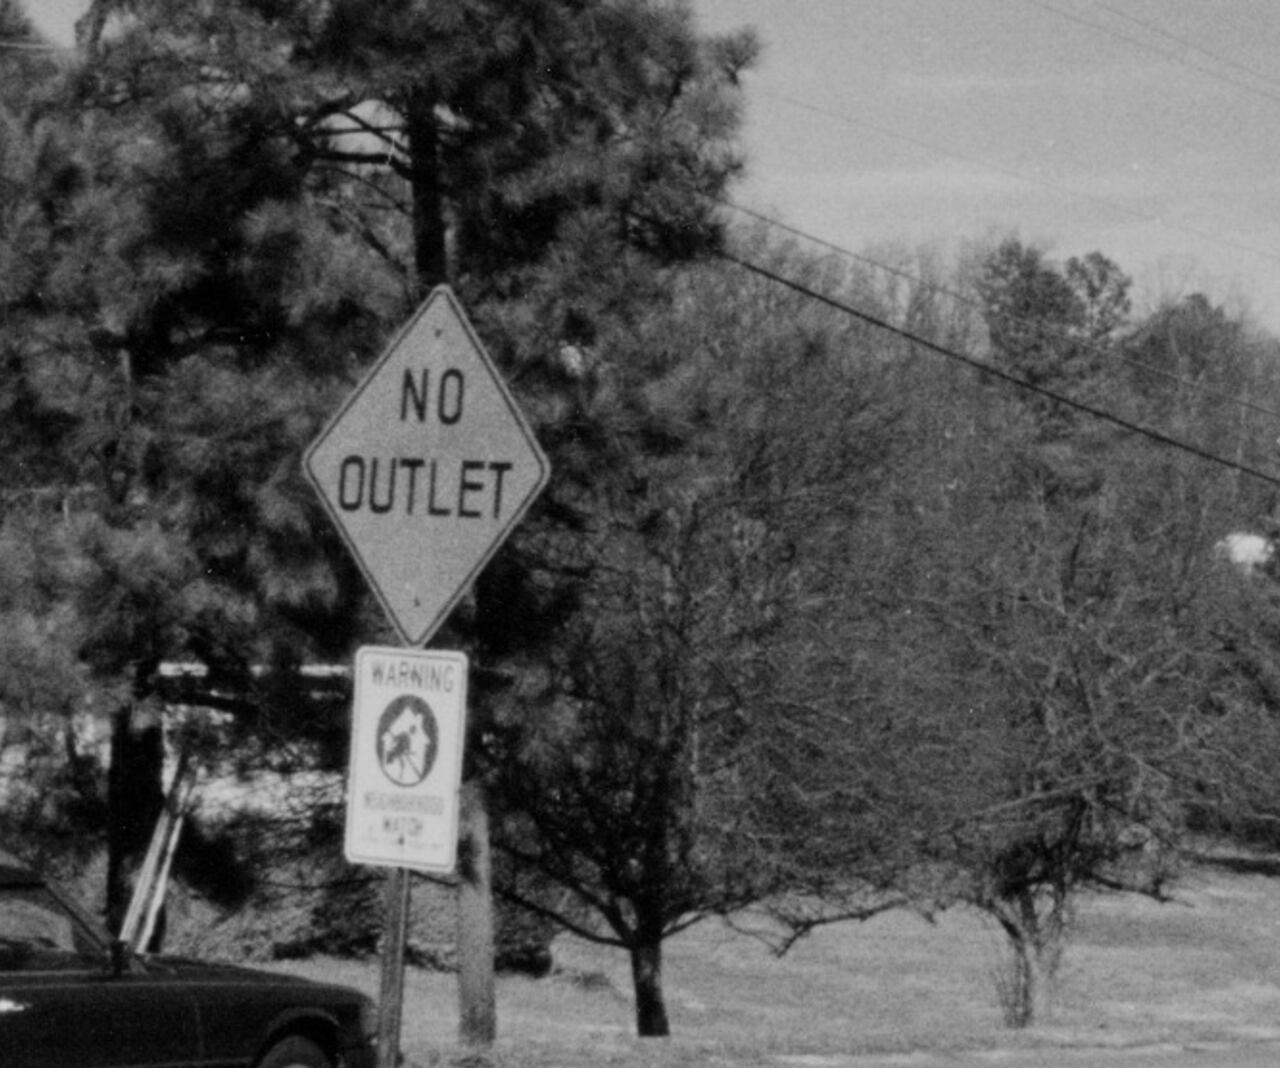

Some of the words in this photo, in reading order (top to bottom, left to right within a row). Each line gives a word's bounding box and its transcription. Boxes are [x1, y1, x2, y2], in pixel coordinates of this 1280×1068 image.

[399, 366, 465, 426] NO
[337, 454, 513, 520] OUTLET
[371, 660, 454, 693] WARNING
